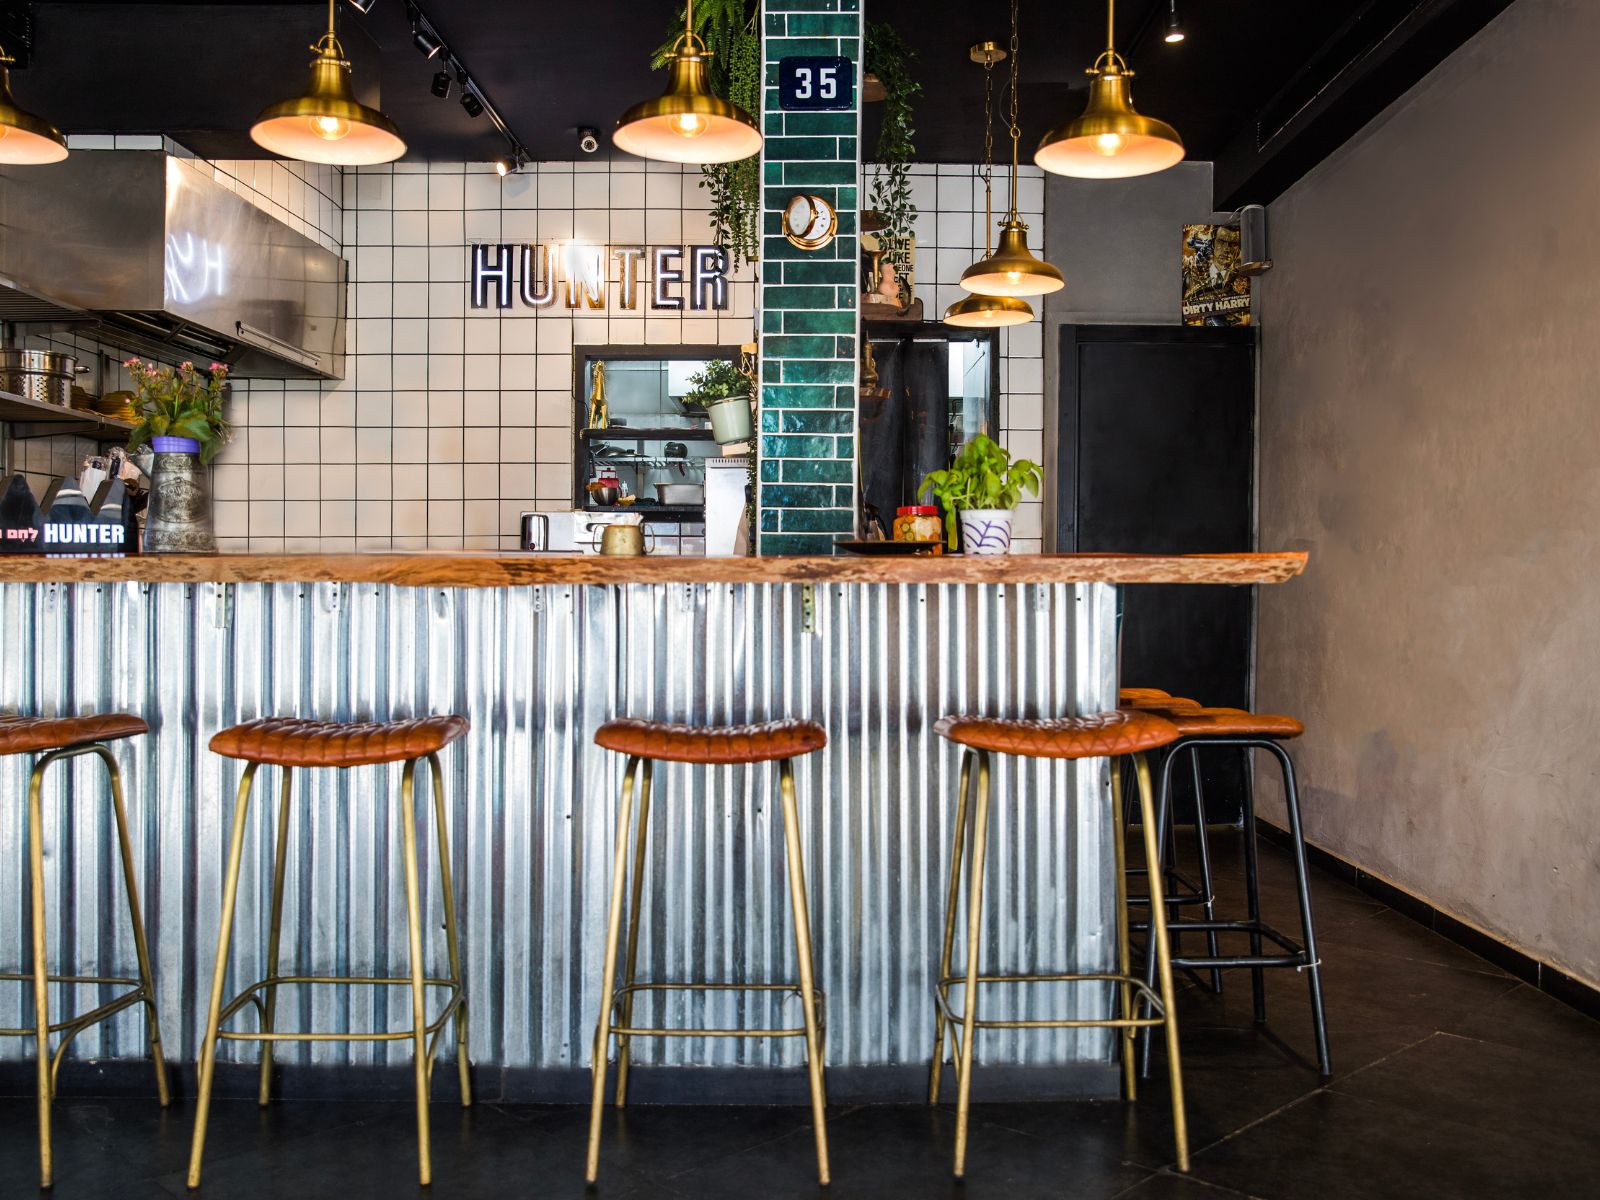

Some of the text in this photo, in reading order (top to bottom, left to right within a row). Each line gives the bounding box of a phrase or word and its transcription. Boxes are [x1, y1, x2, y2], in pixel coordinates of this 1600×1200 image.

[795, 68, 836, 99] 35
[471, 244, 730, 310] HUNTER
[1182, 302, 1214, 315] DIRTY
[1215, 298, 1250, 311] HARRY
[44, 523, 125, 544] HUNTER
